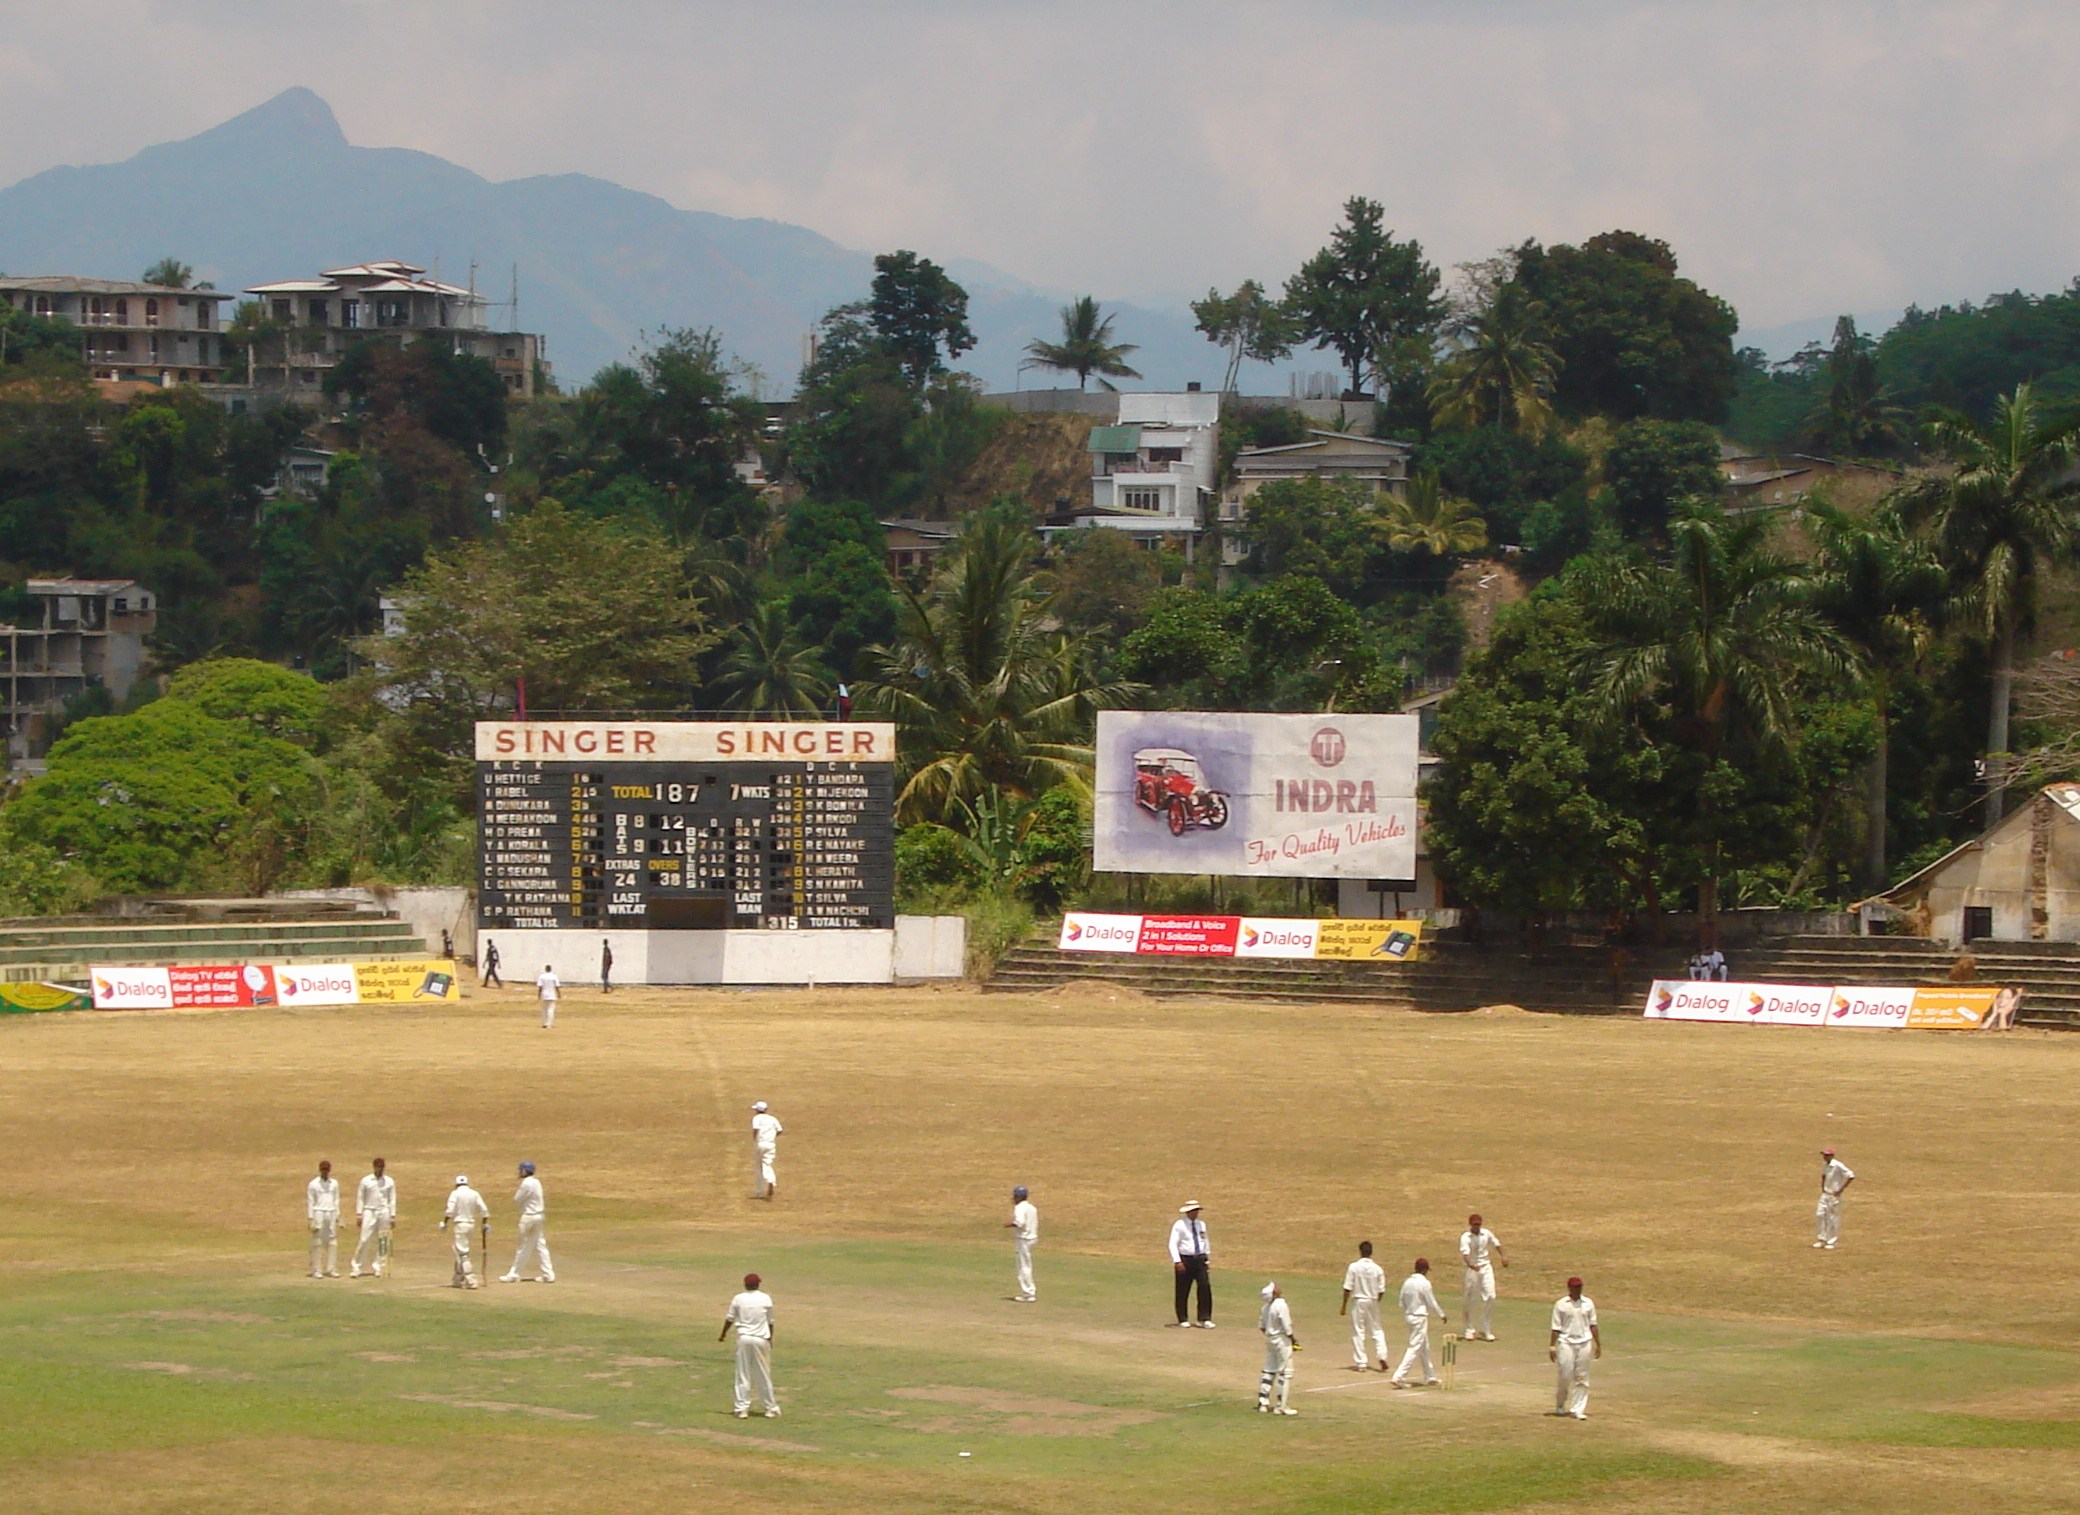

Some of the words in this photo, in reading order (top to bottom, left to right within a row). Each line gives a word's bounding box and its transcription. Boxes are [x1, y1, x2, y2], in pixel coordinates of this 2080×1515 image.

[496, 729, 656, 753] SINGER
[717, 730, 876, 754] SINGER
[494, 762, 501, 770] K
[513, 762, 520, 770] C
[535, 762, 543, 770] K
[829, 762, 836, 771] C
[850, 762, 857, 771] K
[484, 774, 492, 784] U
[495, 774, 541, 784] HETTIGE
[574, 775, 579, 784] 1
[796, 776, 801, 784] 1
[806, 775, 813, 784] Y
[495, 788, 528, 797] RABEL
[572, 787, 581, 798] 2
[583, 787, 597, 797] 15
[611, 786, 653, 798] TOTAL
[655, 784, 700, 803] 187
[730, 784, 740, 800] 7
[741, 787, 770, 798] WKTS
[793, 787, 803, 797] 2
[1276, 779, 1378, 813] INDRA
[572, 800, 581, 811] 3
[793, 800, 803, 811] 3
[805, 802, 813, 811] S
[816, 802, 824, 811] K
[572, 814, 581, 823] 4
[634, 815, 644, 828] 8
[661, 815, 684, 830] 12
[751, 818, 761, 827] W
[793, 815, 802, 824] 4
[805, 815, 813, 824] S
[572, 827, 581, 838] 5
[793, 827, 803, 838] 5
[805, 828, 813, 837] P
[816, 828, 848, 837] SILVA
[1247, 840, 1277, 865] For
[1282, 832, 1341, 860] Quality
[1345, 815, 1407, 846] Vehicles
[486, 841, 493, 850] Y
[497, 841, 504, 850] A
[572, 840, 581, 851] 6
[634, 839, 644, 853] 9
[661, 839, 684, 855] 11
[793, 840, 803, 851] 6
[806, 841, 813, 850] R
[816, 841, 823, 850] E
[485, 854, 491, 863] L
[572, 854, 581, 864] 7
[796, 854, 803, 863] 7
[605, 860, 640, 870] EXTRAS
[648, 860, 679, 870] OVERS
[485, 867, 492, 876] C
[507, 867, 548, 876] SEKARA
[572, 867, 581, 877] 8
[794, 867, 803, 877] 8
[806, 867, 812, 876] L
[816, 867, 855, 876] HERATH
[615, 873, 636, 886] 24
[660, 872, 681, 886] 38
[484, 880, 491, 889] L
[753, 880, 761, 889] 2
[794, 880, 803, 890] 9
[806, 880, 813, 889] S
[515, 894, 522, 903] K
[613, 893, 641, 903] LAST
[735, 893, 762, 902] LAST
[806, 894, 813, 903] T
[816, 894, 847, 903] SILVA
[484, 907, 491, 916] S
[495, 907, 502, 916] P
[572, 907, 581, 916] 11
[737, 904, 762, 914] MAN
[793, 907, 803, 916] 11
[768, 916, 798, 929] 315
[810, 917, 841, 926] TOTAL
[1145, 920, 1192, 929] Broadband
[1193, 921, 1200, 929] &
[1202, 921, 1226, 930] Voice
[1086, 925, 1135, 944] Dialog
[1151, 932, 1159, 940] in
[1166, 932, 1206, 941] Solutions
[1262, 930, 1312, 949] Dialog
[1156, 943, 1174, 951] Your
[1199, 944, 1210, 952] Or
[1210, 944, 1233, 953] Office
[171, 972, 199, 981] Dialog
[117, 980, 166, 1000] Dialog
[301, 976, 351, 994] Dialog
[1676, 994, 1730, 1014] Dialog
[1768, 997, 1821, 1017] Dialog
[1853, 1000, 1907, 1019] Dialog
